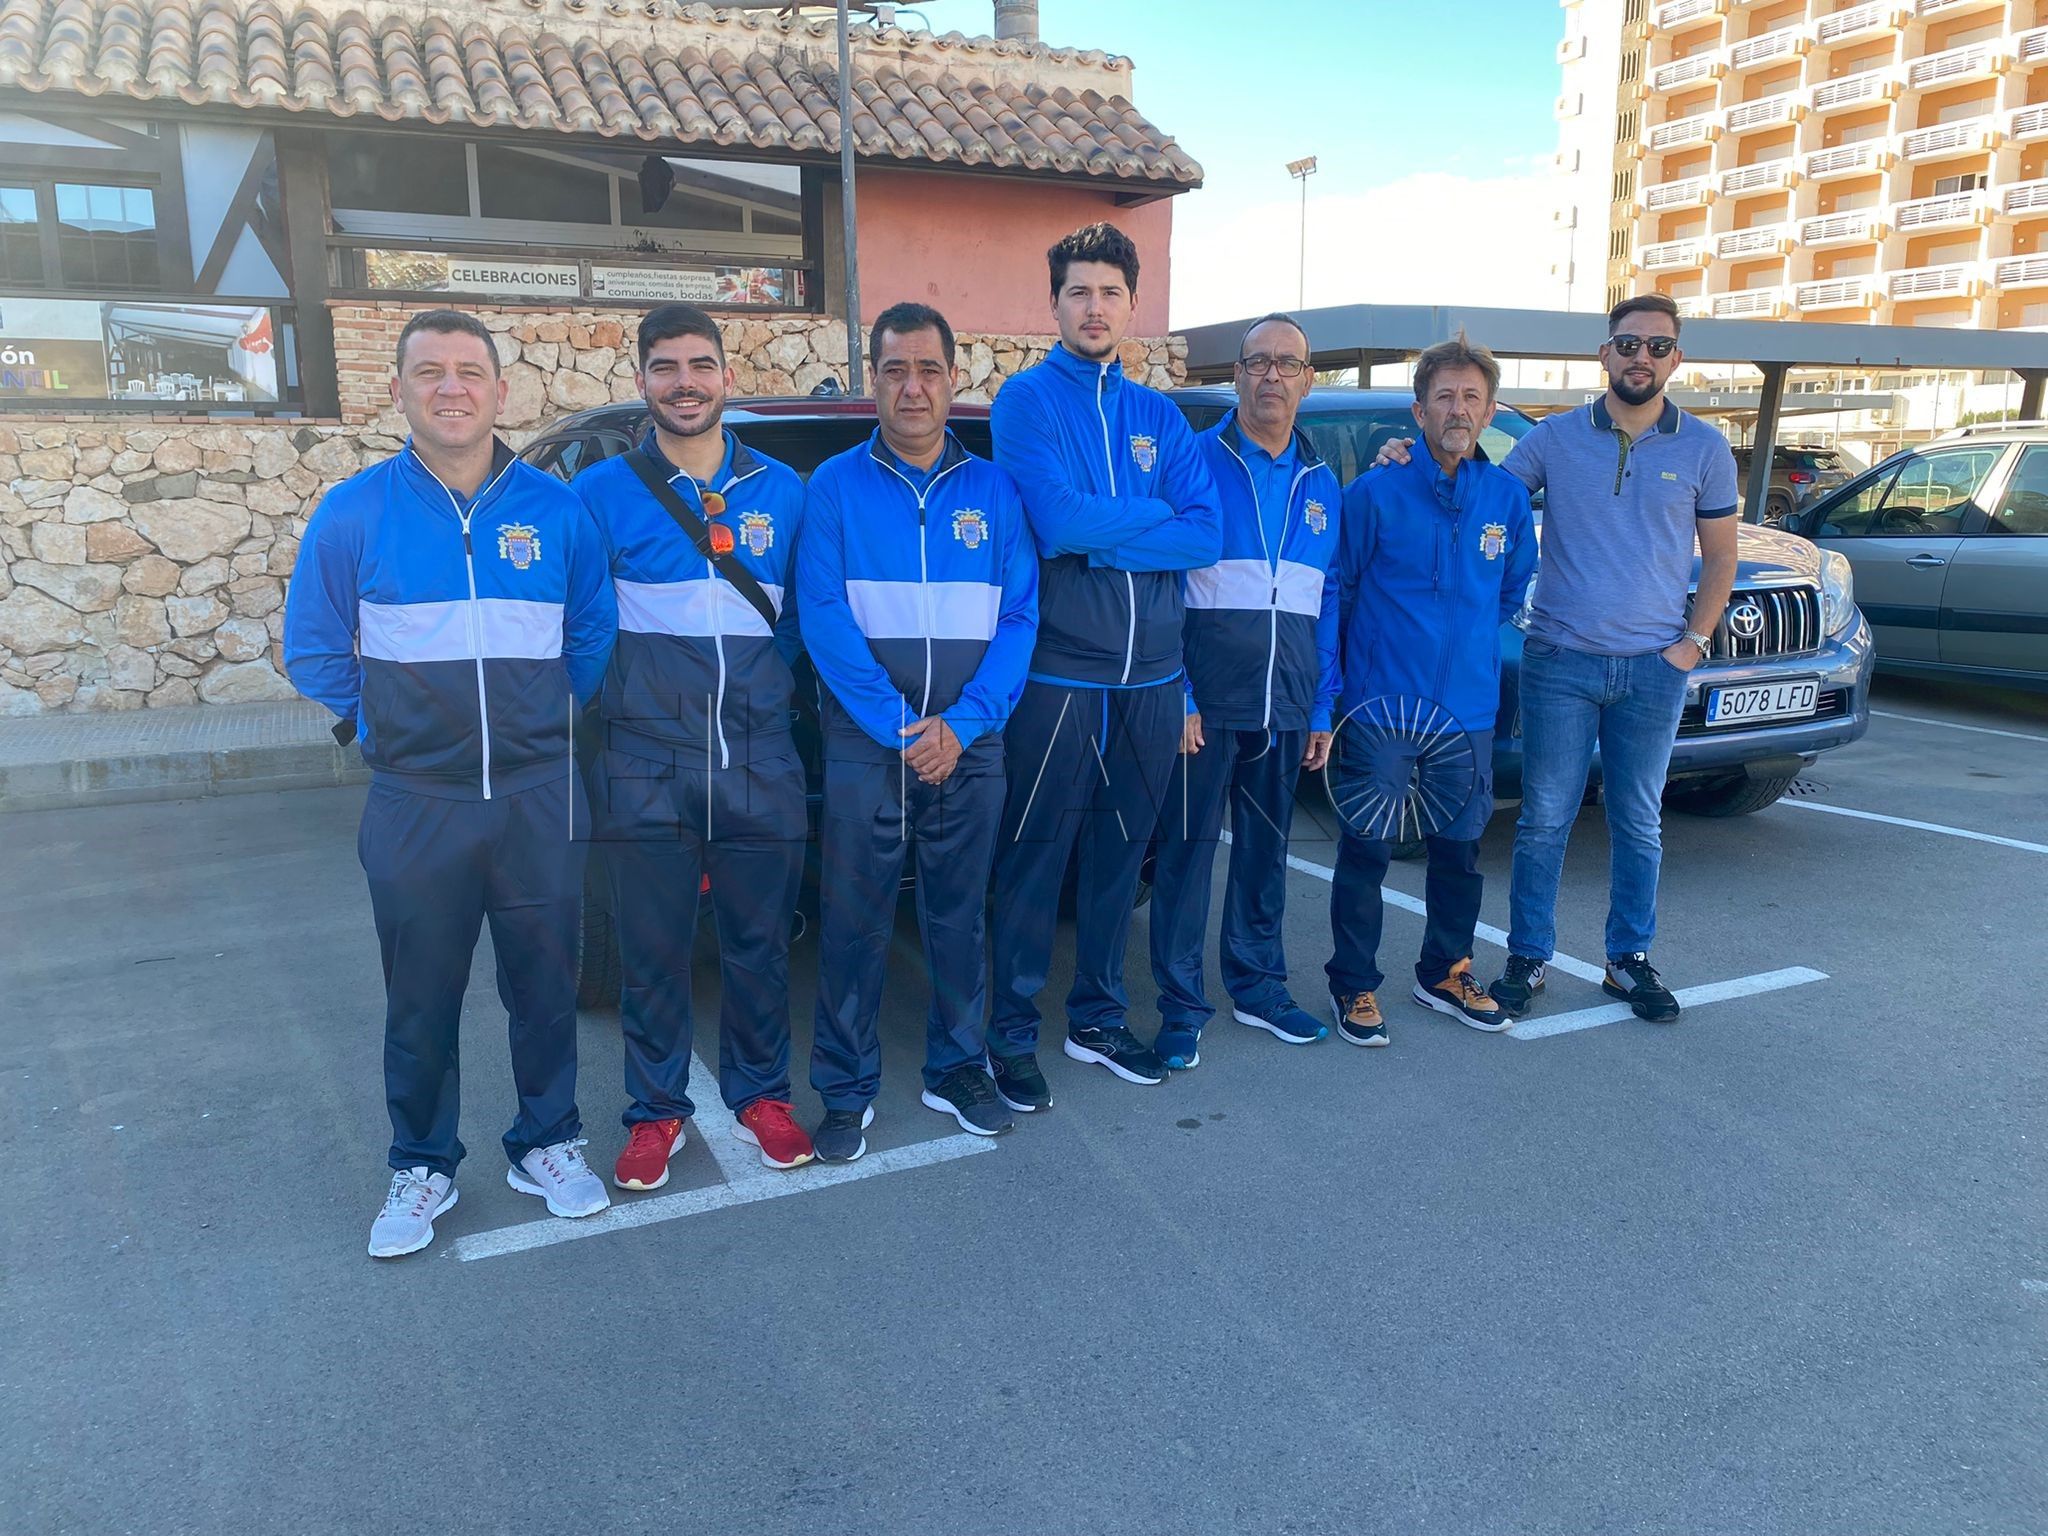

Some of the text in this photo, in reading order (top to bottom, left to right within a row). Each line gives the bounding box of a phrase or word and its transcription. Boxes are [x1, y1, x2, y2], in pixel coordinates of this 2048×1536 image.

[452, 269, 577, 286] CELEBRACIONES
[608, 288, 714, 300] comuniones, bodas
[0, 369, 69, 389] NTIL
[1721, 685, 1814, 715] 5078 LFD
